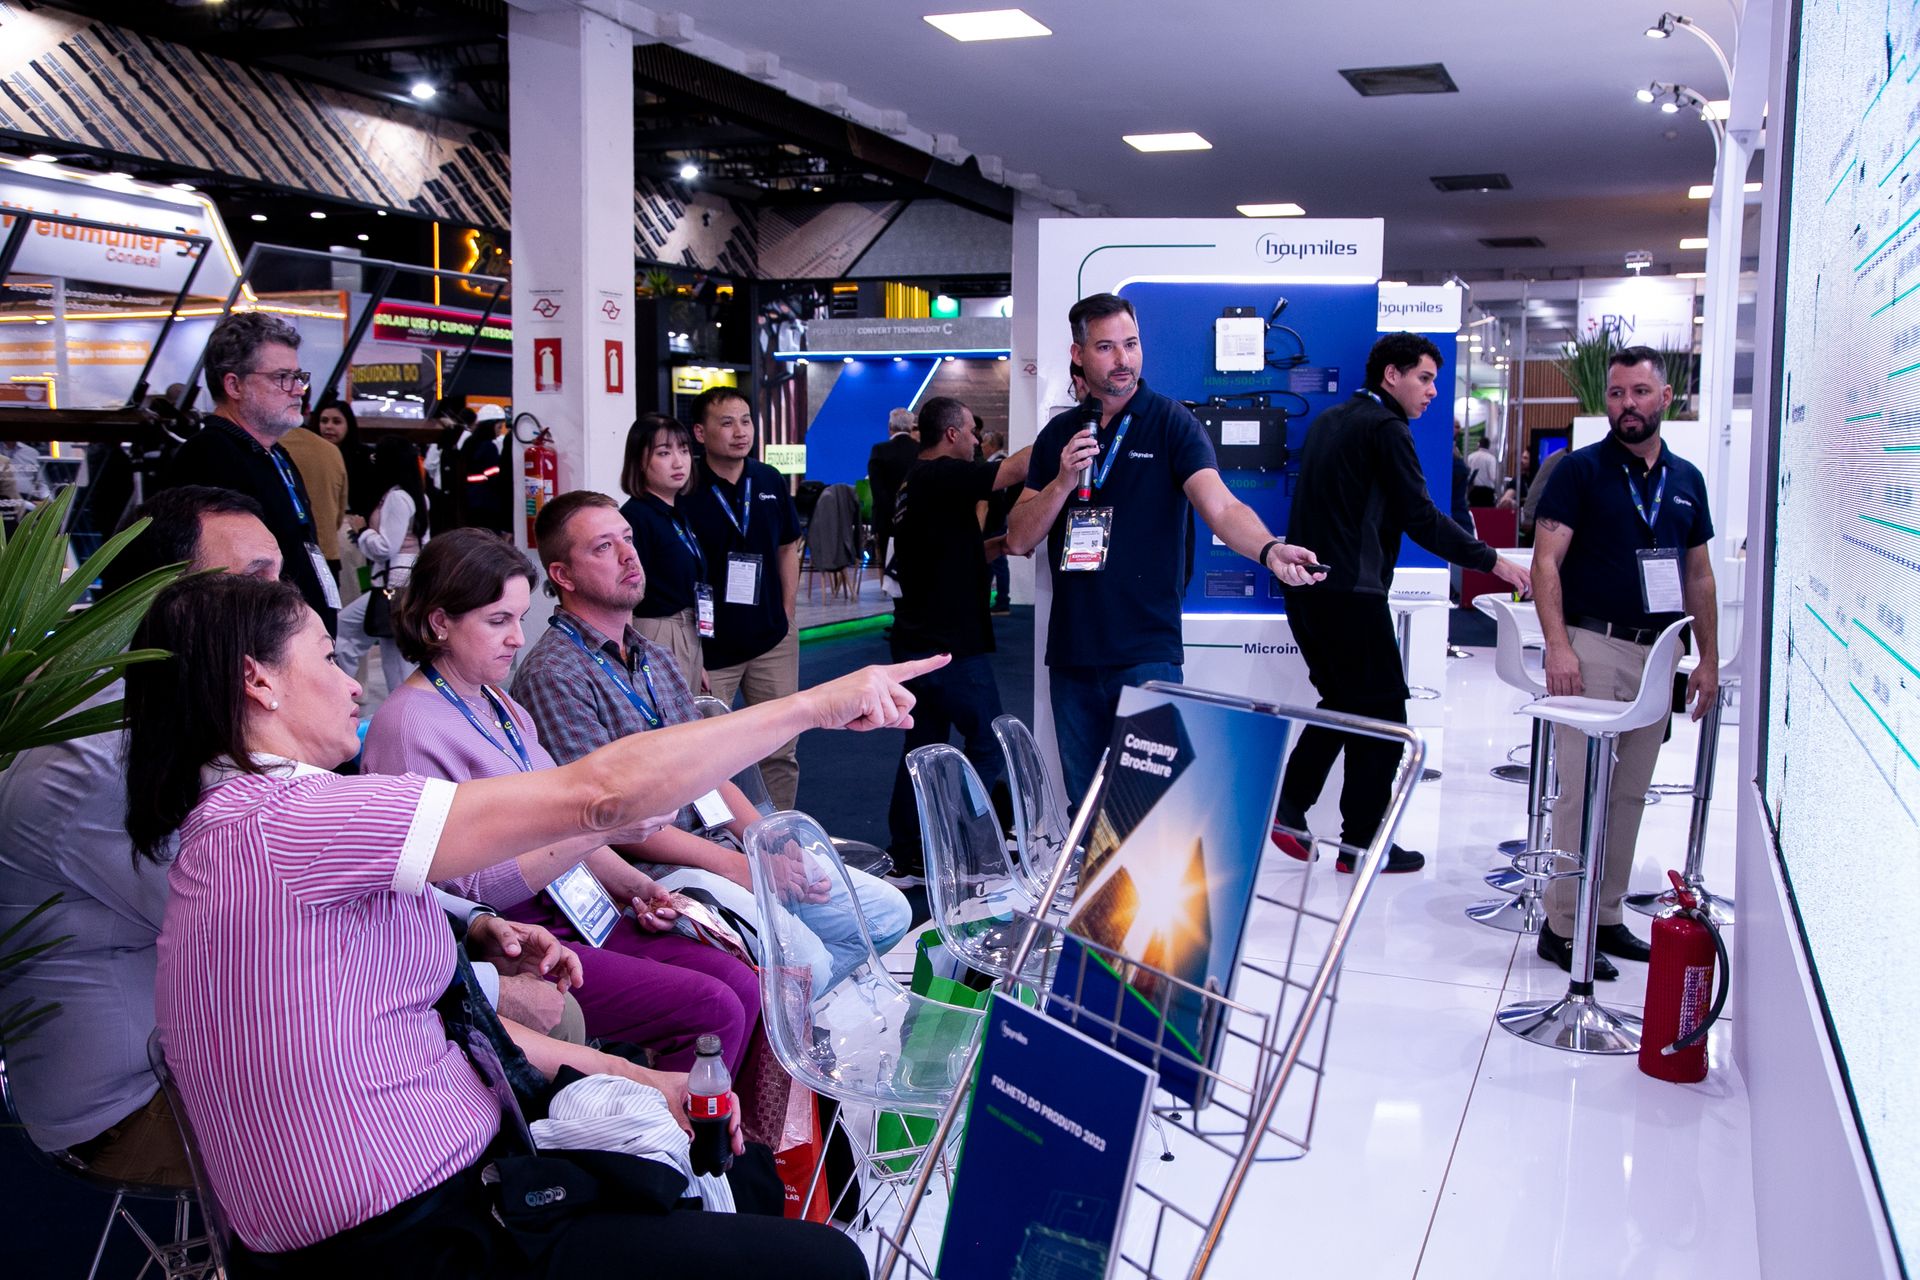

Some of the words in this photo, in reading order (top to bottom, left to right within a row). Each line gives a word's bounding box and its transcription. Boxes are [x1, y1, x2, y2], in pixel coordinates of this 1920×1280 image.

[106, 247, 161, 269] Conexel
[1265, 239, 1358, 260] hoymiles
[1378, 301, 1443, 316] hoymiles
[411, 317, 429, 330] USE
[430, 319, 439, 329] O
[857, 327, 892, 336] CONVERT
[893, 326, 941, 335] TECHNOLOGY
[1244, 642, 1299, 655] Microin
[1124, 733, 1178, 762] Company
[1120, 751, 1172, 778] Brochure
[991, 1074, 1028, 1105] FOLHETO
[1027, 1096, 1041, 1113] DO
[1040, 1104, 1083, 1138] PRODUTO
[1082, 1129, 1107, 1152] 2023
